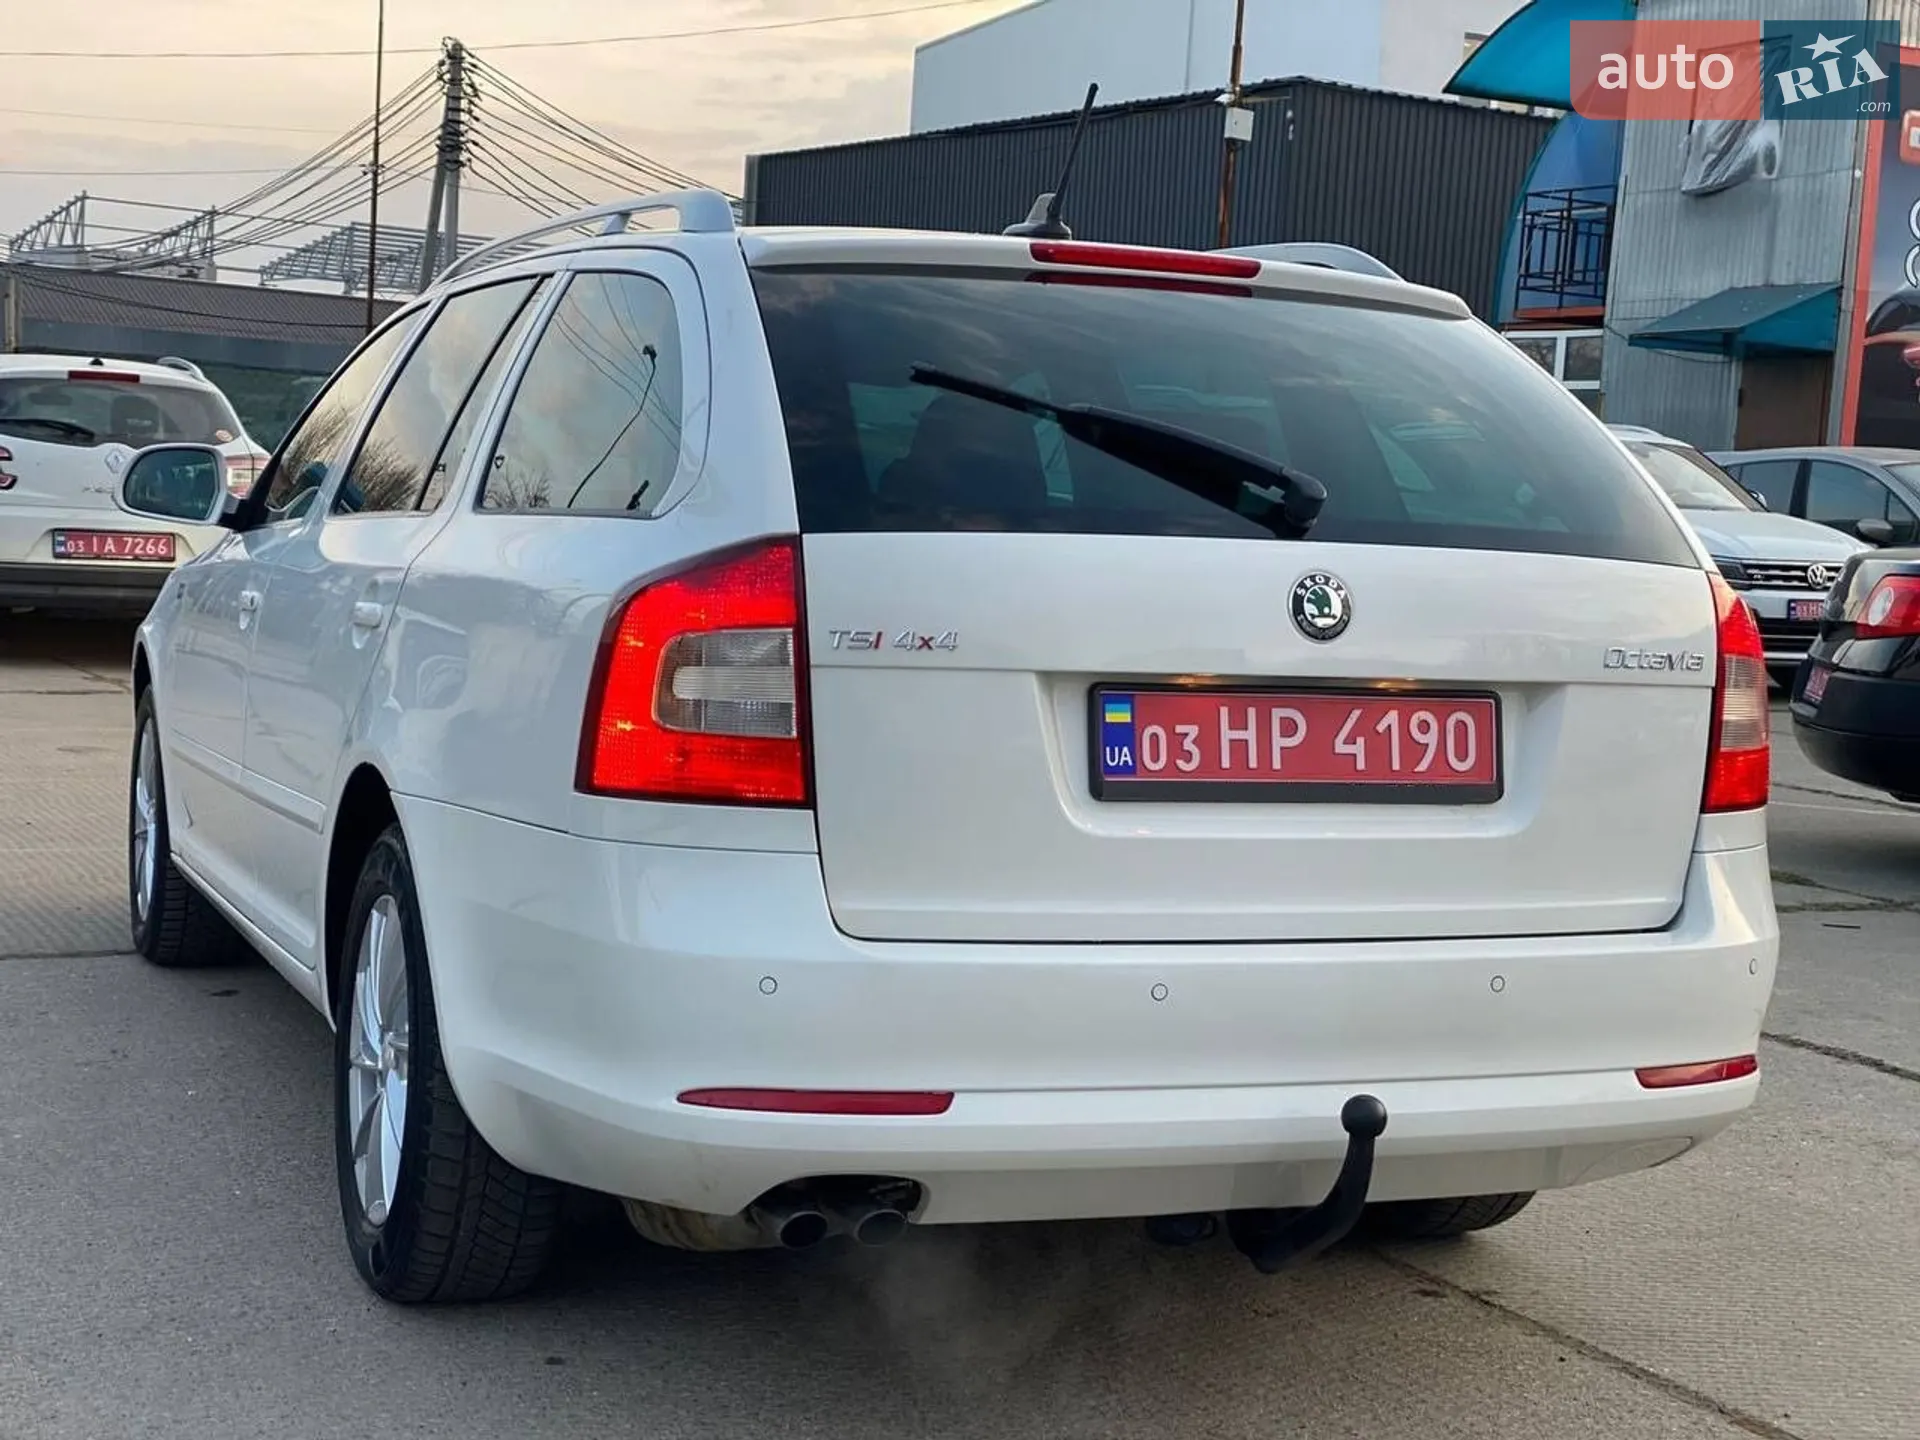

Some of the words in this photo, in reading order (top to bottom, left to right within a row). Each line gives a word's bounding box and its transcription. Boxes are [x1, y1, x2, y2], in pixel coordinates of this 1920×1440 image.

[66, 540, 85, 553] 03
[92, 535, 116, 553] IA
[122, 536, 168, 555] 7266
[828, 629, 883, 651] TSI
[892, 626, 959, 651] 4x4
[1602, 647, 1705, 672] Octavia
[1105, 746, 1133, 767] UA
[1141, 724, 1201, 773] 03
[1218, 705, 1308, 771] HP
[1333, 707, 1478, 773] 4190
